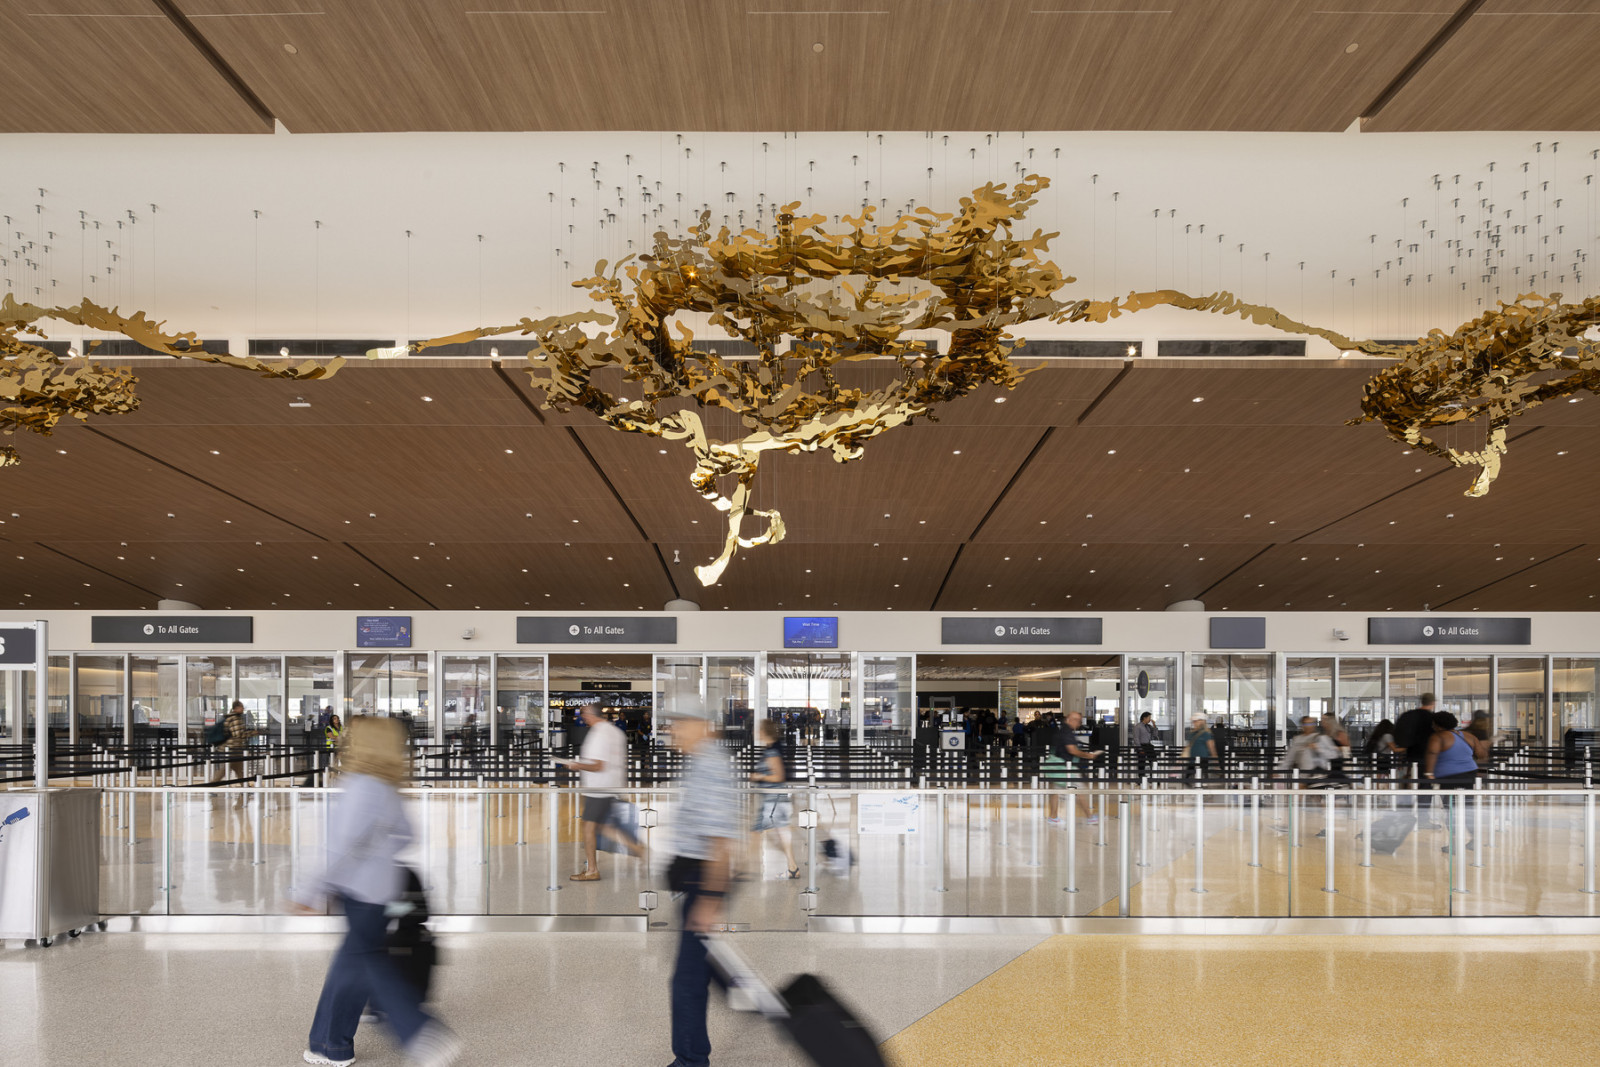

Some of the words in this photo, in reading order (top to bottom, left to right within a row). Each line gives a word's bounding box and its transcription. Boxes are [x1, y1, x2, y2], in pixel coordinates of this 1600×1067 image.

[158, 625, 167, 634] To
[168, 625, 178, 634] All
[179, 625, 199, 634] Gates
[583, 626, 592, 635] To
[593, 626, 603, 635] All
[605, 626, 625, 635] Gates
[1009, 626, 1018, 635] To
[1019, 626, 1029, 635] All
[1030, 626, 1051, 635] Gates
[1437, 626, 1446, 635] To
[1447, 626, 1458, 635] All
[1459, 626, 1479, 635] Gates
